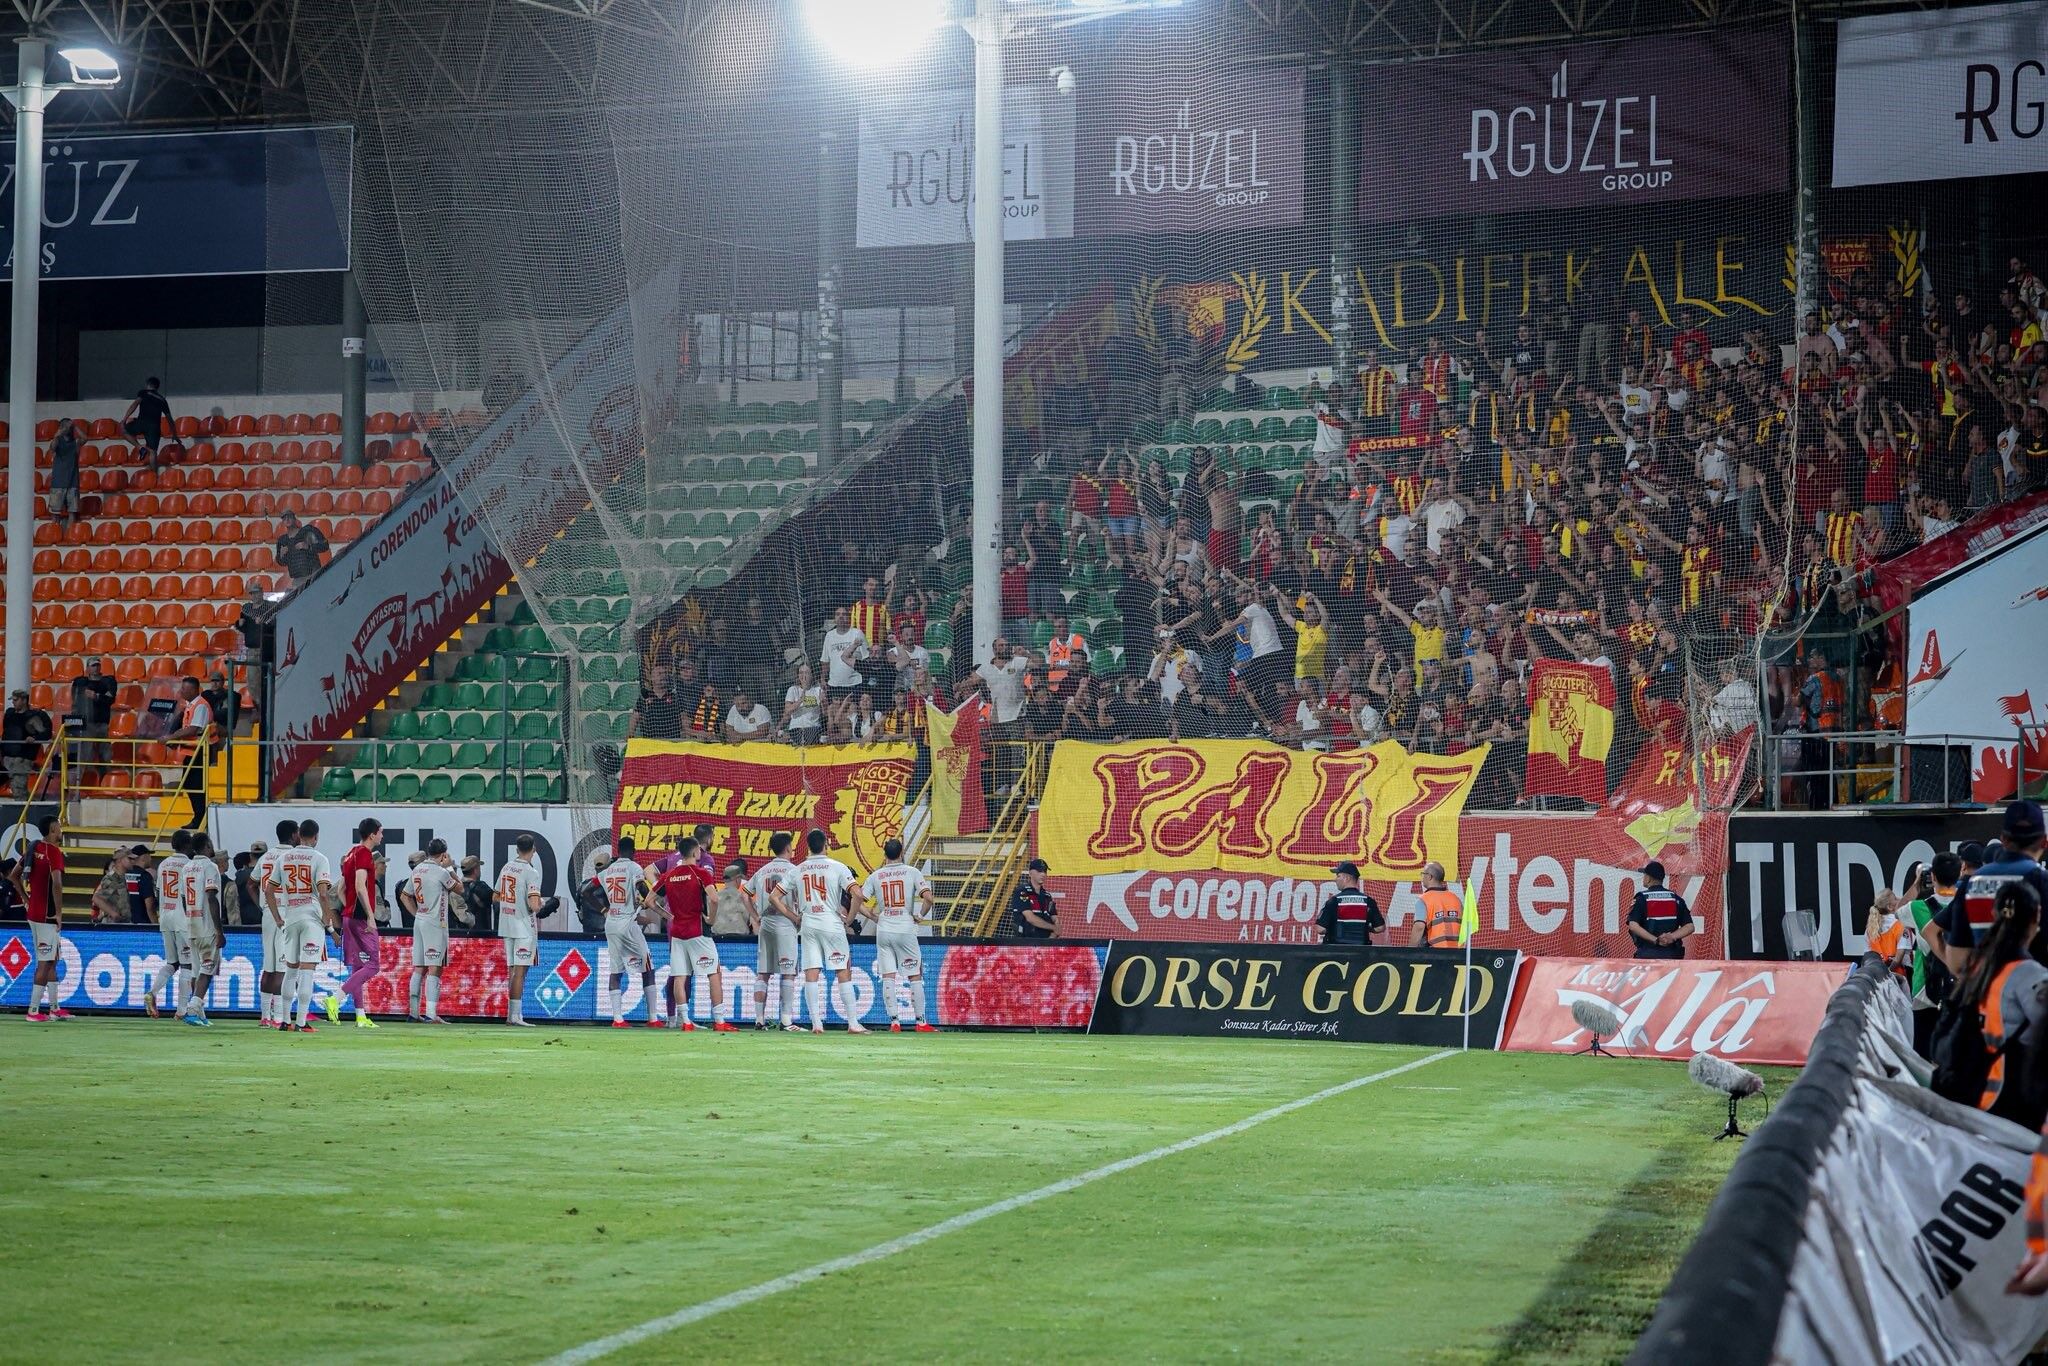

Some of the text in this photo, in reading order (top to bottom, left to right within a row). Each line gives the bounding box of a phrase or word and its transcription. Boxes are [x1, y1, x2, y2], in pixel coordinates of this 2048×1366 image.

[1602, 171, 1672, 191] GROUP
[1003, 204, 1040, 218] ROUP
[1216, 191, 1269, 206] GROUP
[1360, 437, 1417, 451] GÖZTEPE
[371, 493, 438, 569] CORENDON
[359, 600, 404, 649] ALANYASPOR
[619, 783, 821, 819] KORKMA İZMİR
[162, 870, 179, 898] 12
[283, 864, 312, 894] 39
[500, 874, 517, 904] 13
[669, 874, 692, 883] GÖZTEPE
[802, 873, 828, 902] 14
[881, 879, 906, 908] 10
[1111, 954, 1494, 1017] ORSE GOLD
[1220, 1019, 1260, 1031] Sonsuza
[1261, 1019, 1292, 1033] Kadar
